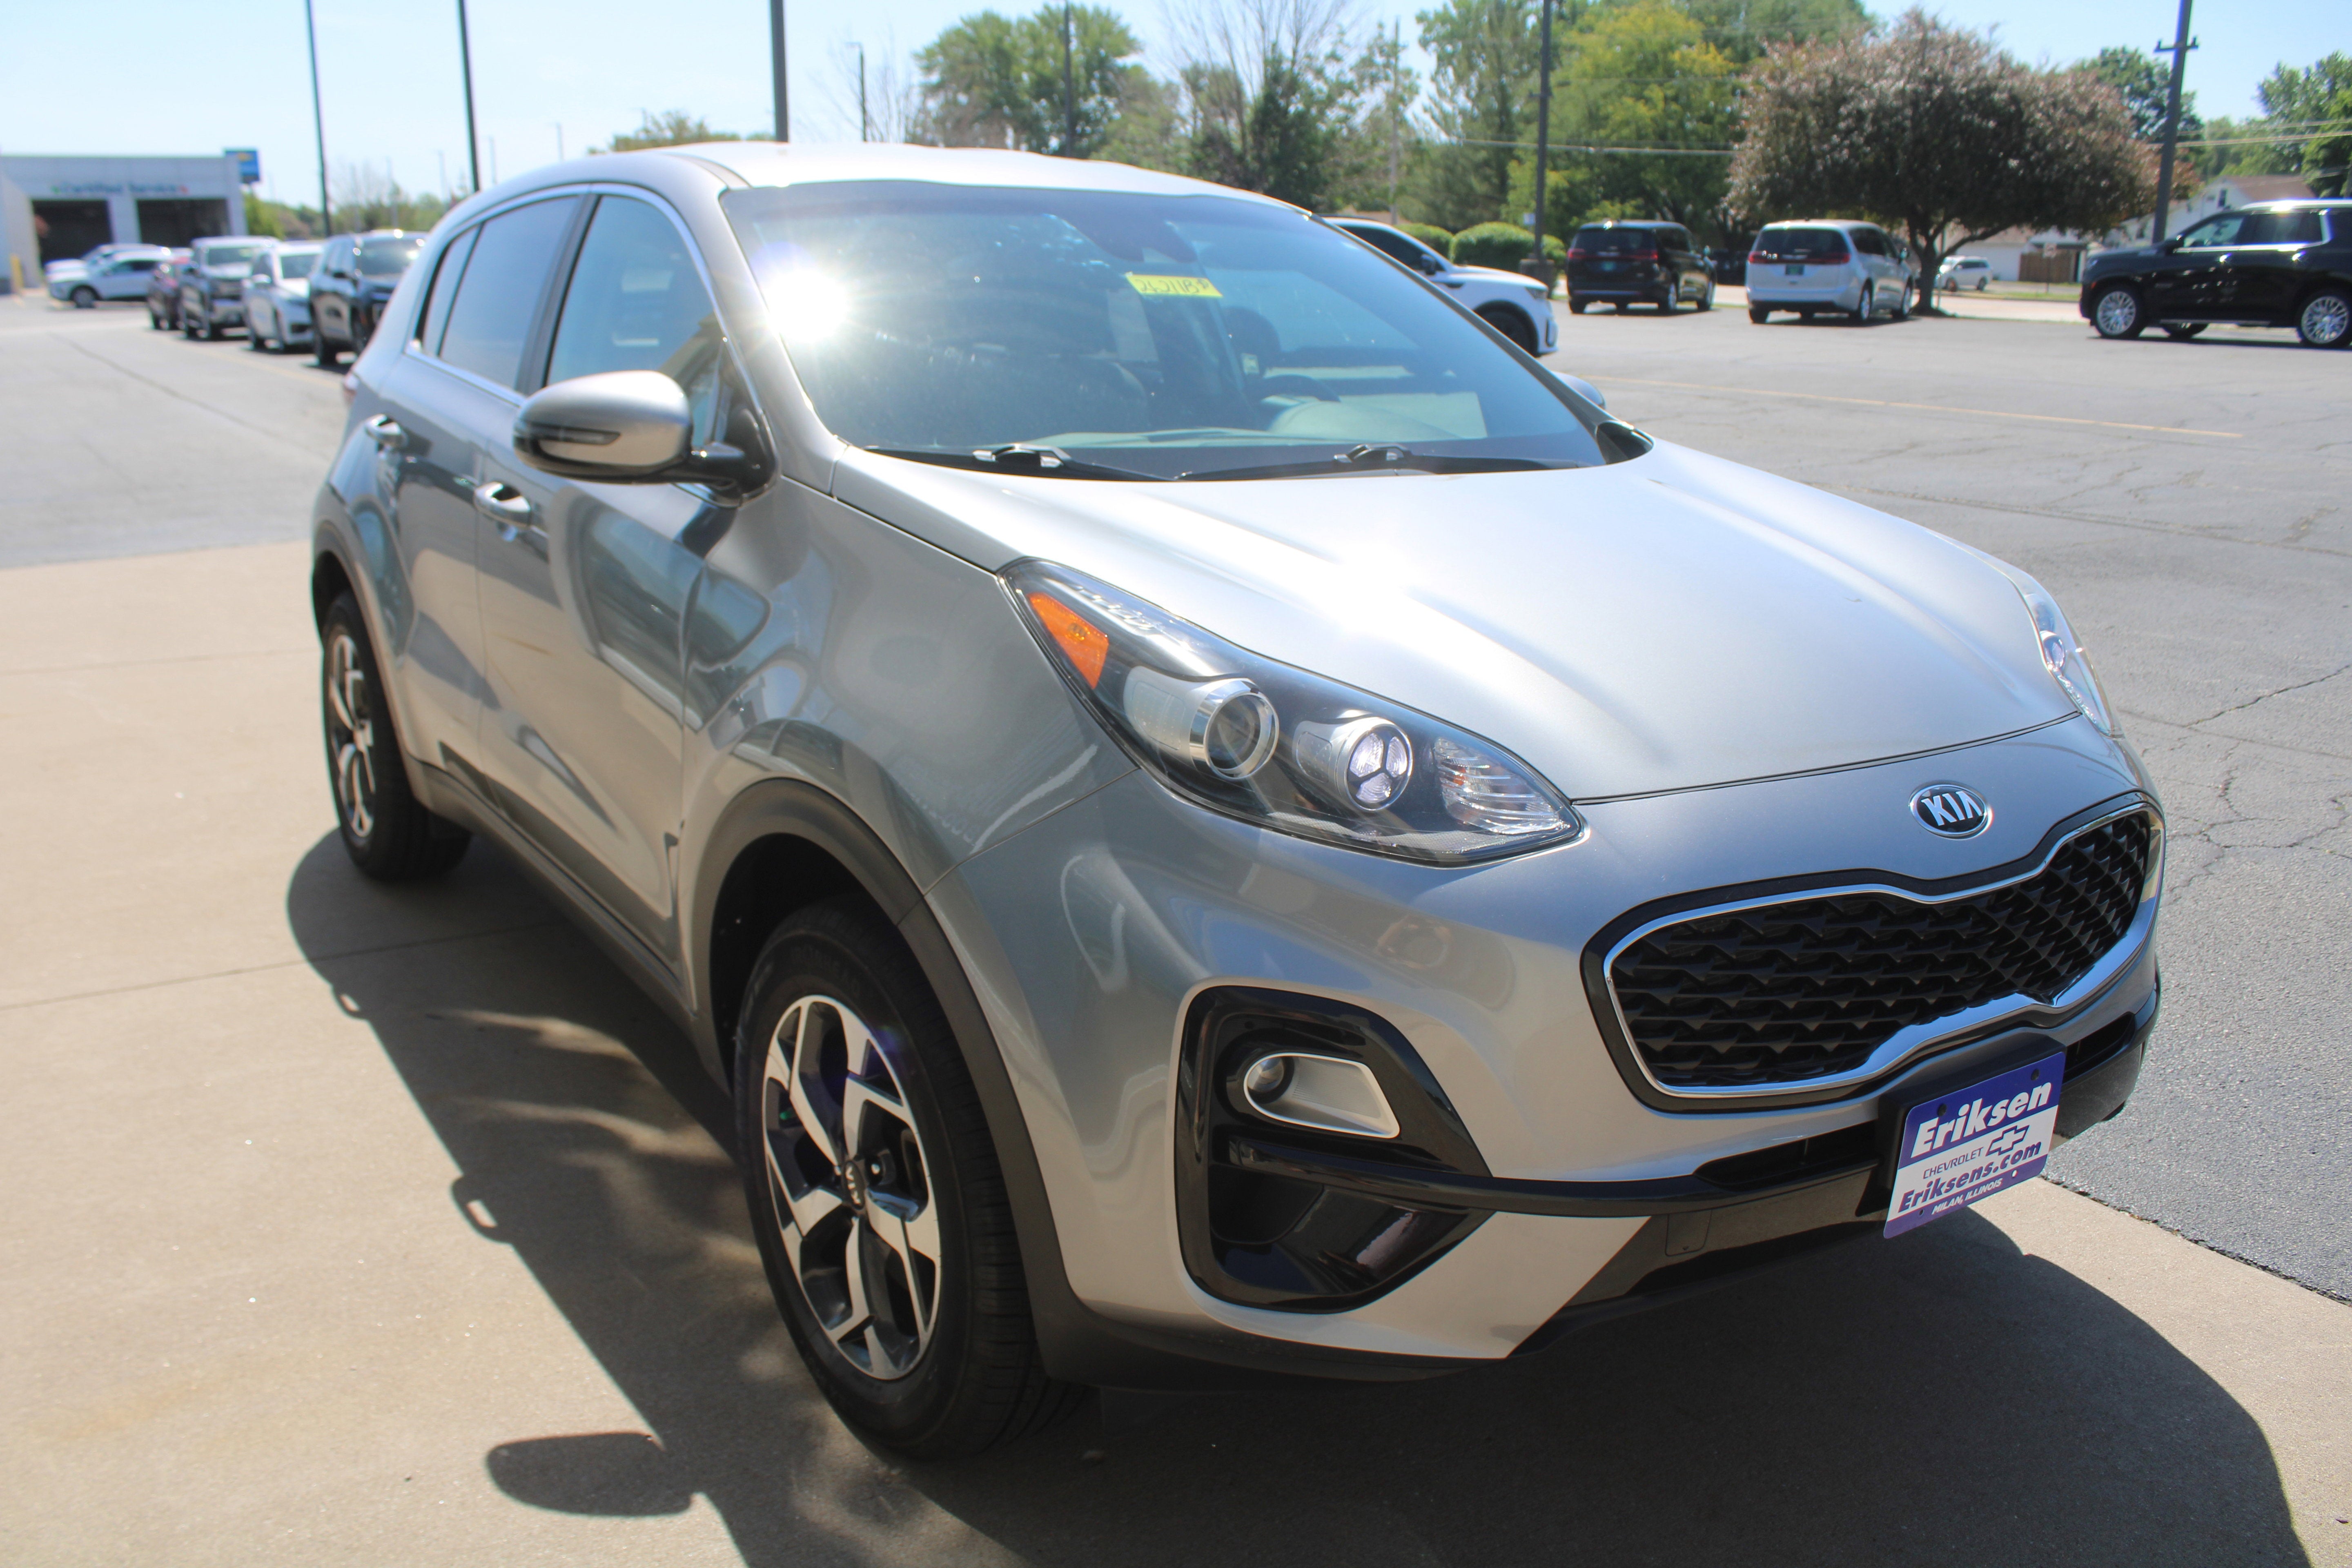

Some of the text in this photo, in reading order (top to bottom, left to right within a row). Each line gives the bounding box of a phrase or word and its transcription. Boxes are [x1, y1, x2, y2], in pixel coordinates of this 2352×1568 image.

[1920, 791, 1983, 826] KIA
[1911, 1082, 2052, 1158] Eriksen
[1898, 1141, 2042, 1213] Eriksens.com
[1922, 1146, 1984, 1179] CHEVROLET
[1931, 1178, 2003, 1215] MILAN, ILLINOIS
